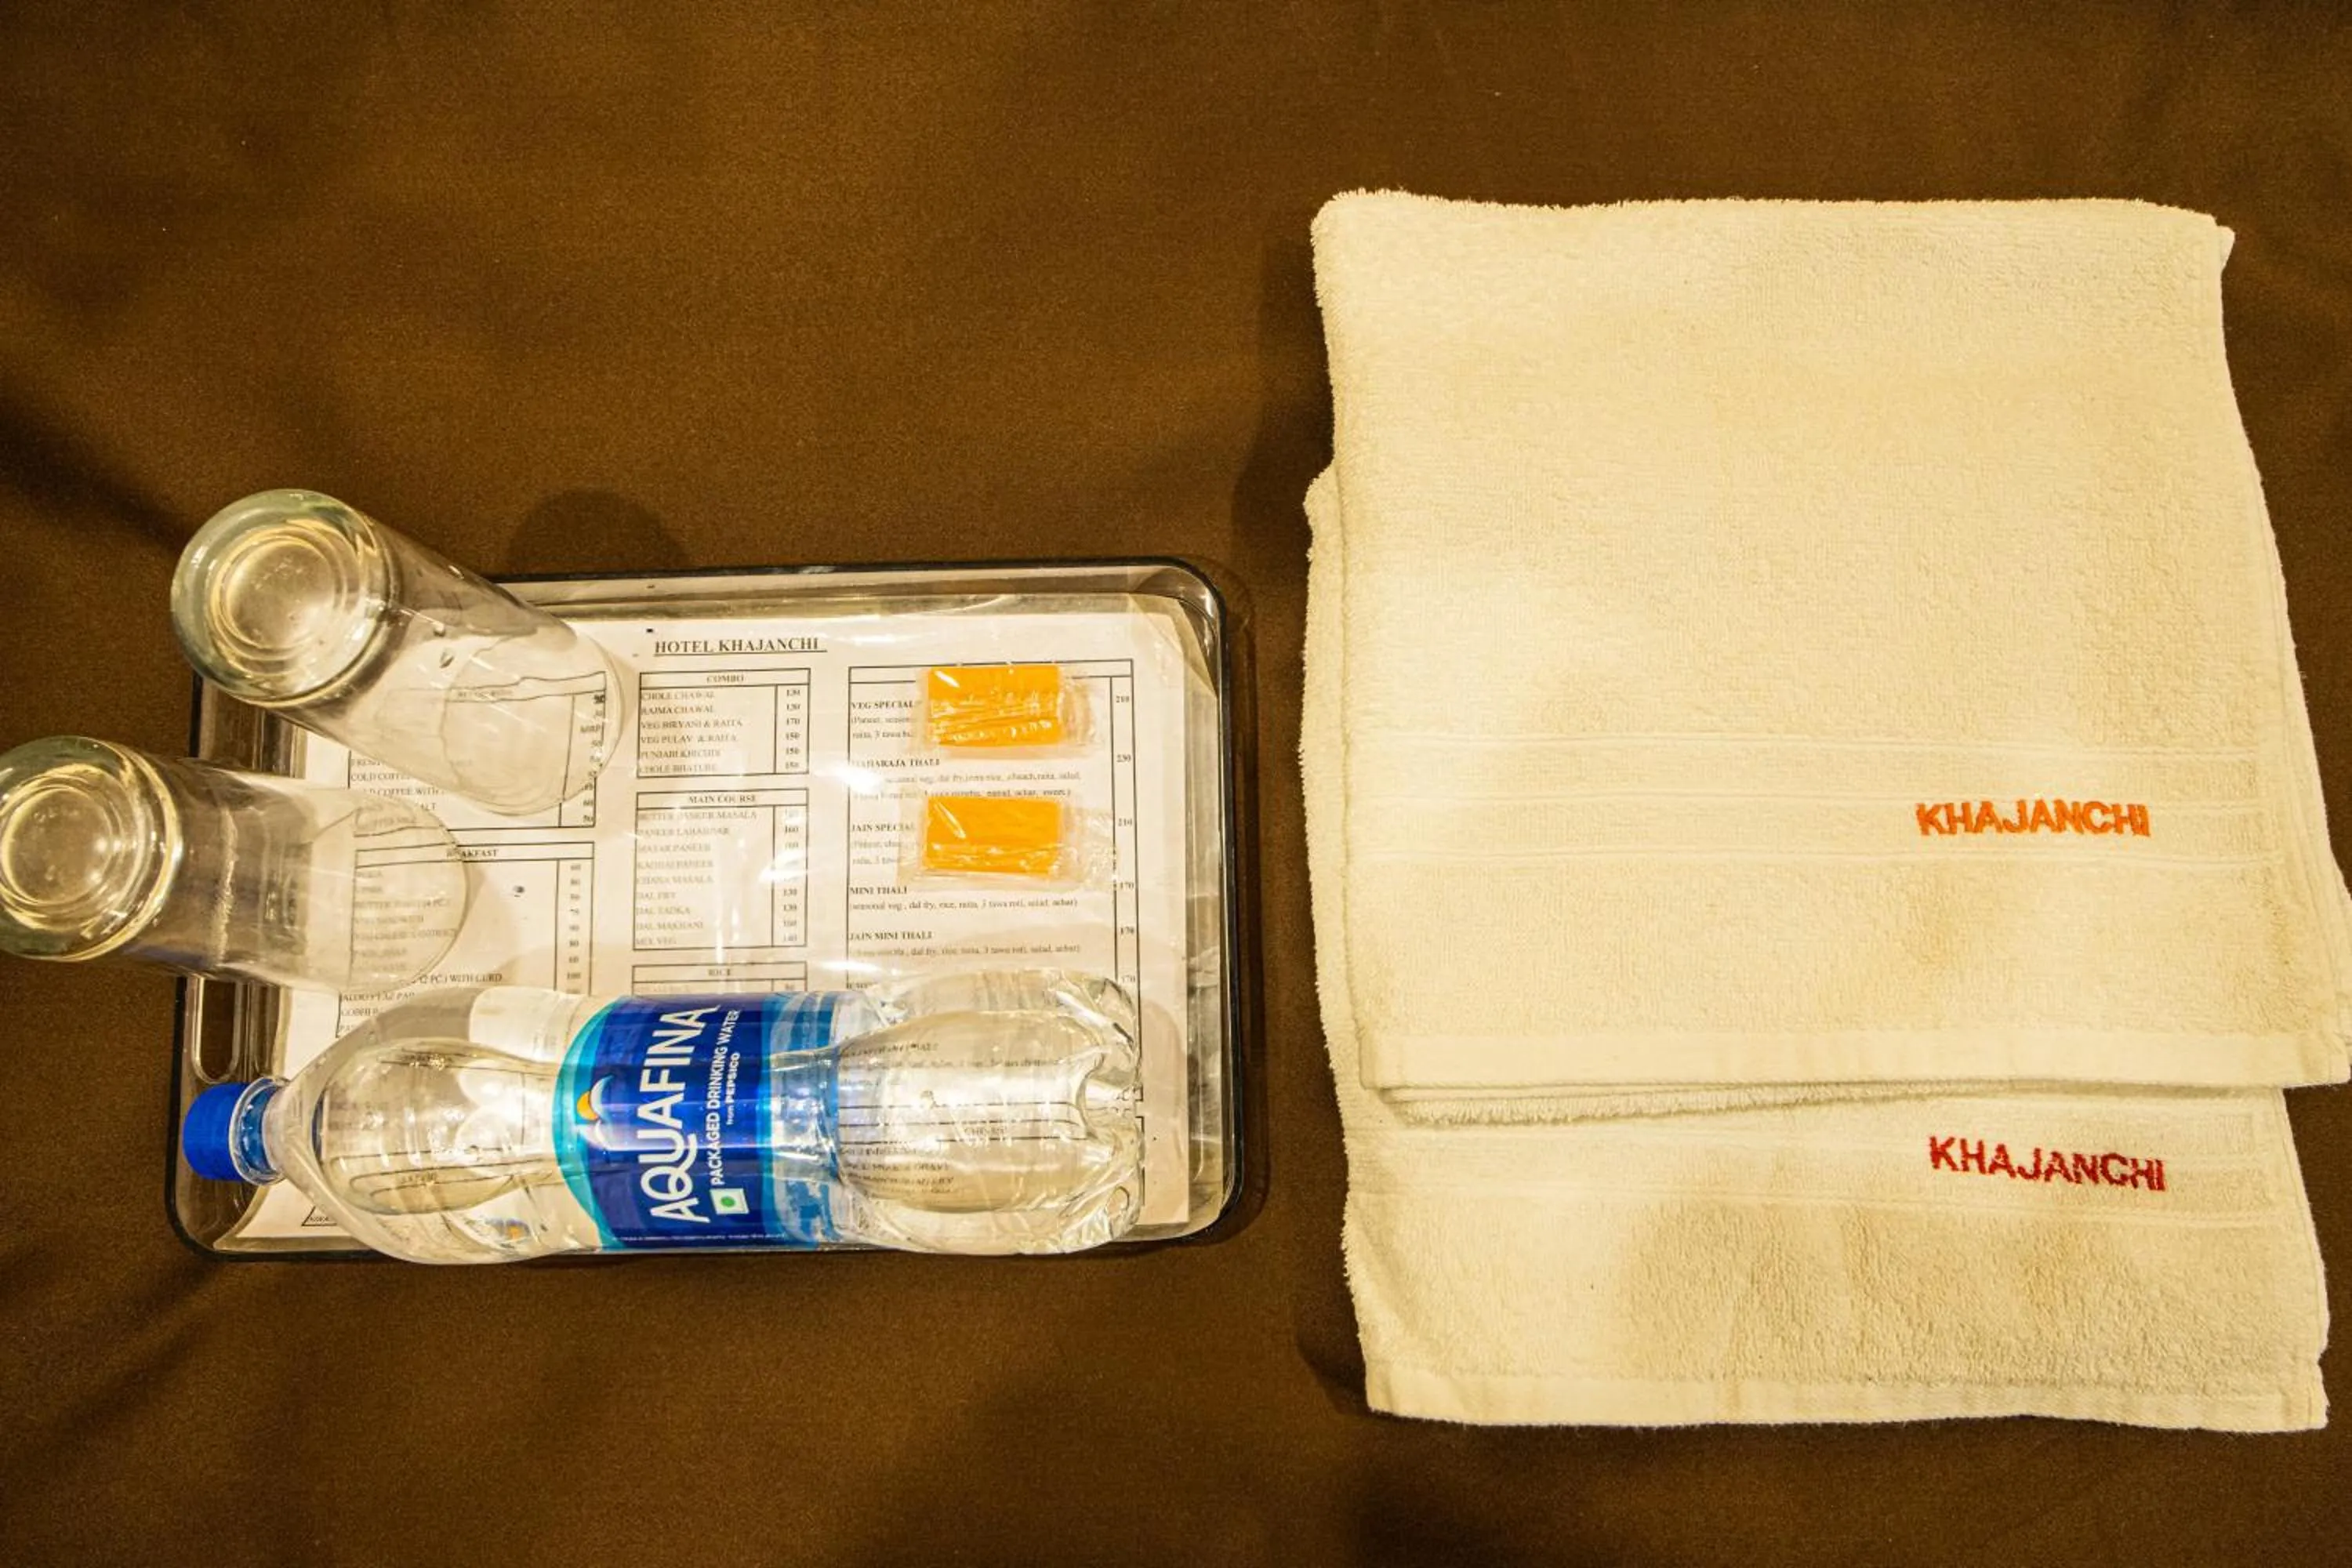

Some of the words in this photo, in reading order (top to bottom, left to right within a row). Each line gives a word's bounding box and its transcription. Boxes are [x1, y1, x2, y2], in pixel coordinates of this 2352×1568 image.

[655, 640, 713, 654] HOTEL
[718, 637, 819, 652] KHAJANCHI
[706, 673, 745, 684] COMBO
[641, 706, 673, 715] RAJMA
[851, 701, 872, 710] VEG
[873, 700, 914, 709] SPECIAL
[640, 735, 660, 744] VEG
[909, 758, 940, 767] THALI
[688, 796, 714, 804] MAIN
[717, 794, 757, 804] COURSE
[1915, 798, 2152, 837] KHAJANCHI
[851, 823, 873, 832] JAIN
[877, 886, 908, 895] THALI
[849, 931, 873, 941] JAIN
[874, 931, 898, 940] MINI
[902, 931, 933, 940] THALI
[720, 1008, 741, 1044] WATER
[706, 1046, 728, 1109] DRINKING
[724, 1051, 742, 1105] PEPSICO
[637, 1004, 720, 1224] AQUAFINA
[725, 1104, 735, 1125] from
[706, 1112, 725, 1185] PACKAGED
[1928, 1135, 2166, 1192] KHAJANCHI
